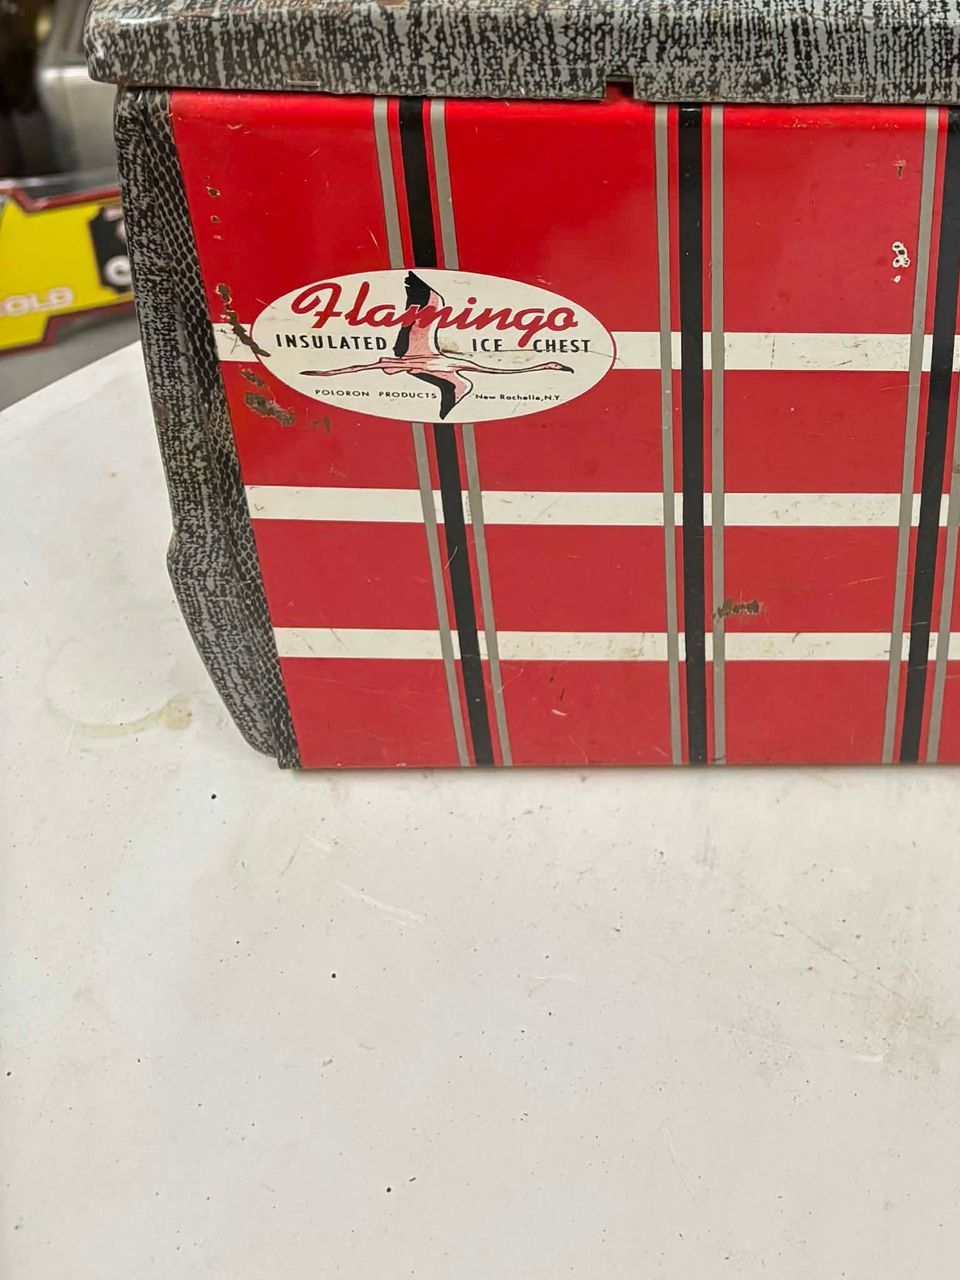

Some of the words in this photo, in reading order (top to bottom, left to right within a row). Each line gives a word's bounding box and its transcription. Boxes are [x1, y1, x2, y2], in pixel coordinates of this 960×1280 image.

[0, 287, 74, 318] OLD
[290, 281, 579, 348] Flamingo
[275, 333, 388, 352] INSULATED
[472, 338, 503, 353] ICE
[533, 338, 592, 354] CHEST
[314, 389, 370, 397] POLORON
[378, 391, 438, 399] PRODUCTS
